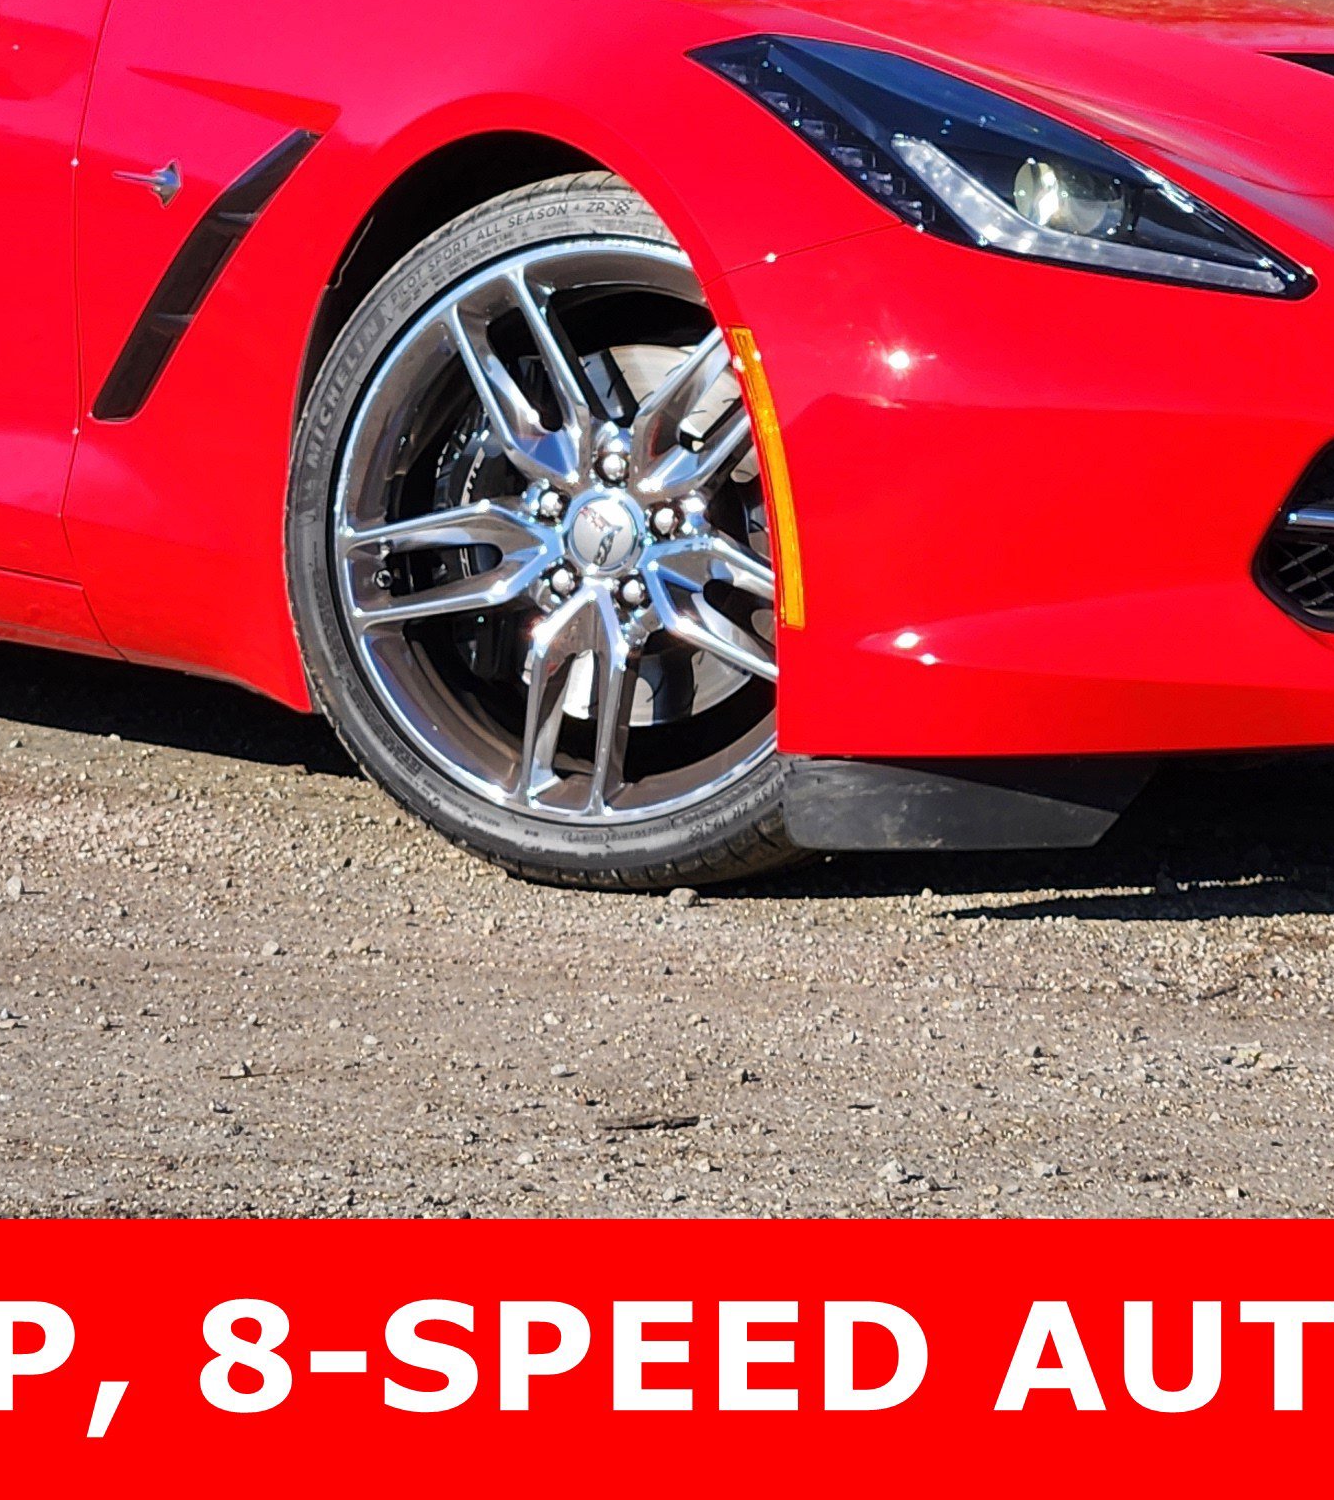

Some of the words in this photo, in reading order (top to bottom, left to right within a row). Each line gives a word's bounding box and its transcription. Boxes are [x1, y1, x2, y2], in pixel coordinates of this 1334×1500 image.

[390, 269, 422, 306] PILOT
[428, 238, 470, 273] SPORT
[476, 223, 501, 241] ALL
[508, 203, 568, 229] SEASON
[307, 320, 380, 469] MICHELIN
